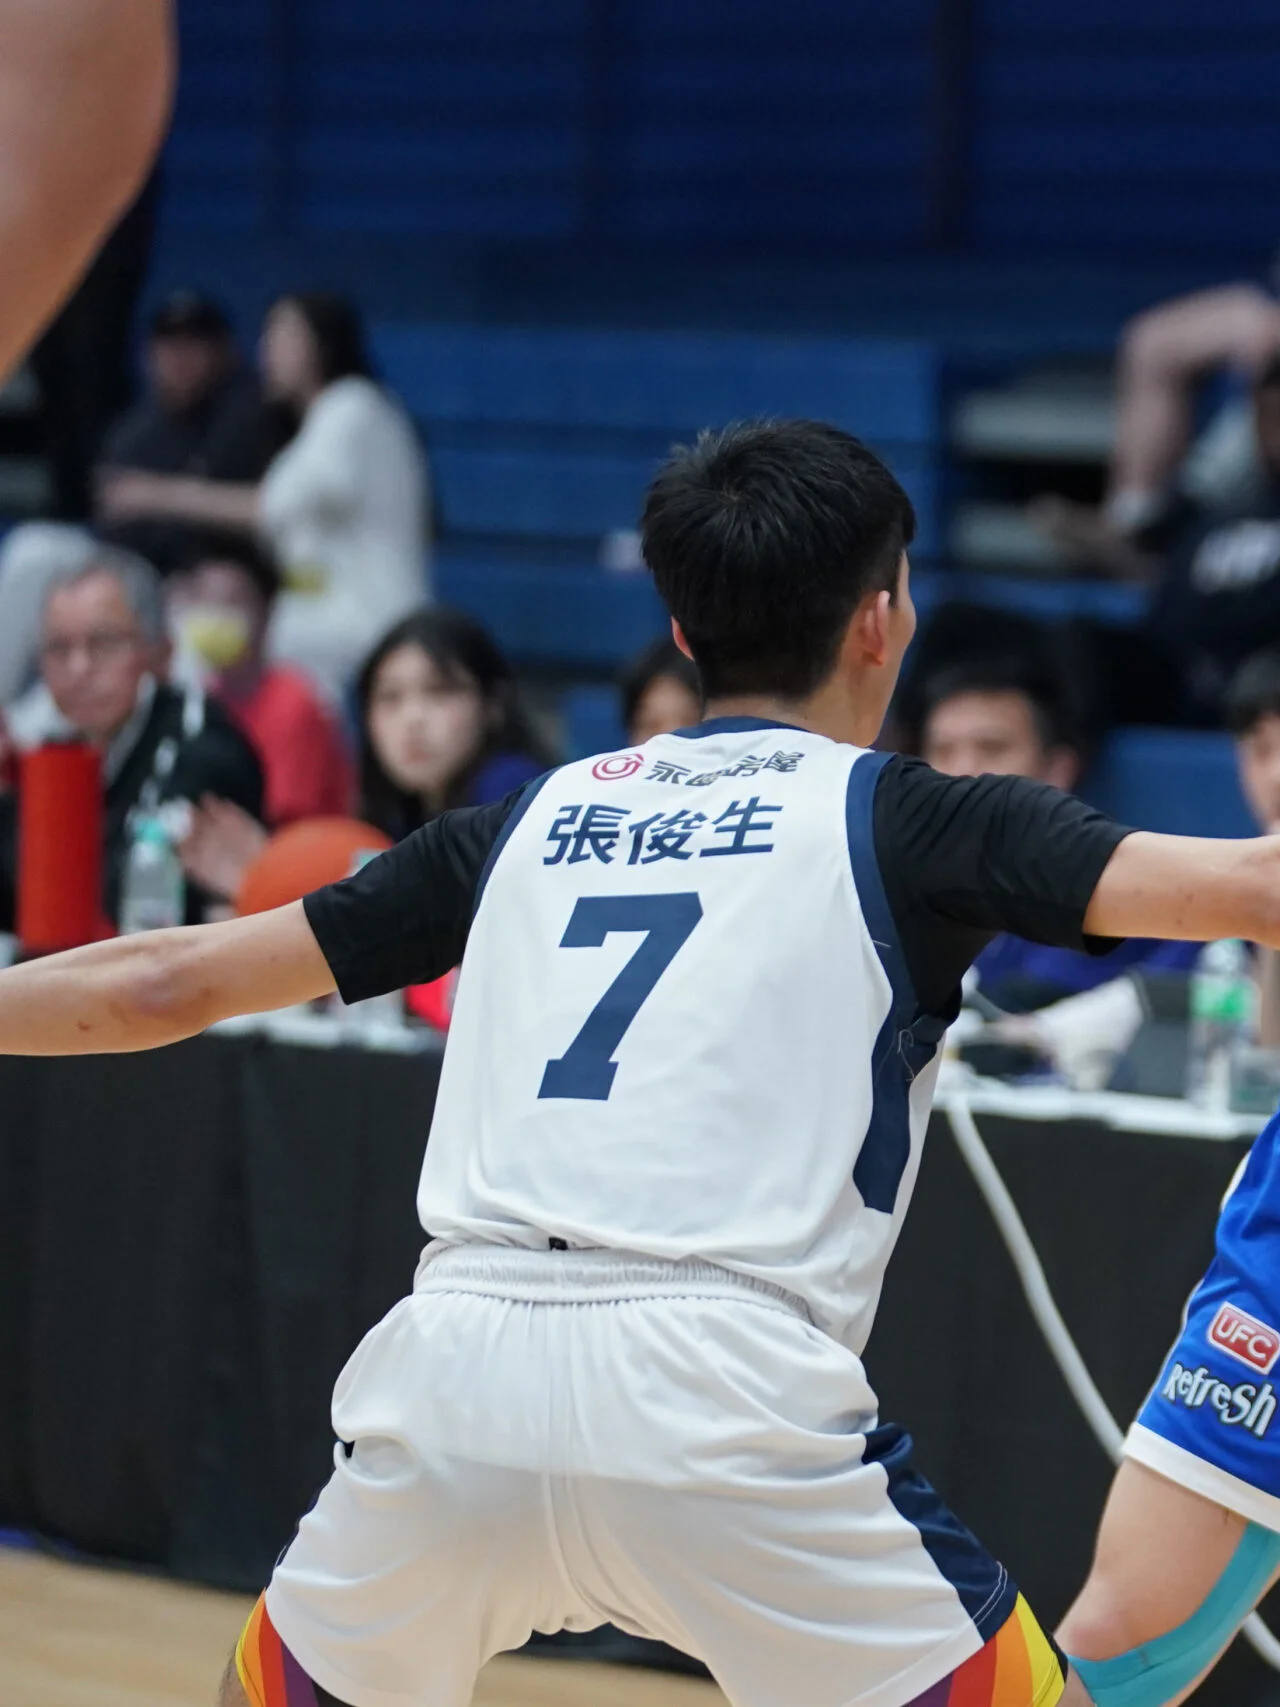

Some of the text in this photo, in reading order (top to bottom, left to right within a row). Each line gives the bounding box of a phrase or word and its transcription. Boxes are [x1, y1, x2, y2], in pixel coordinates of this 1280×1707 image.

[542, 796, 784, 866] 張俊生
[537, 891, 704, 1101] 7
[1216, 1315, 1273, 1360] UFC
